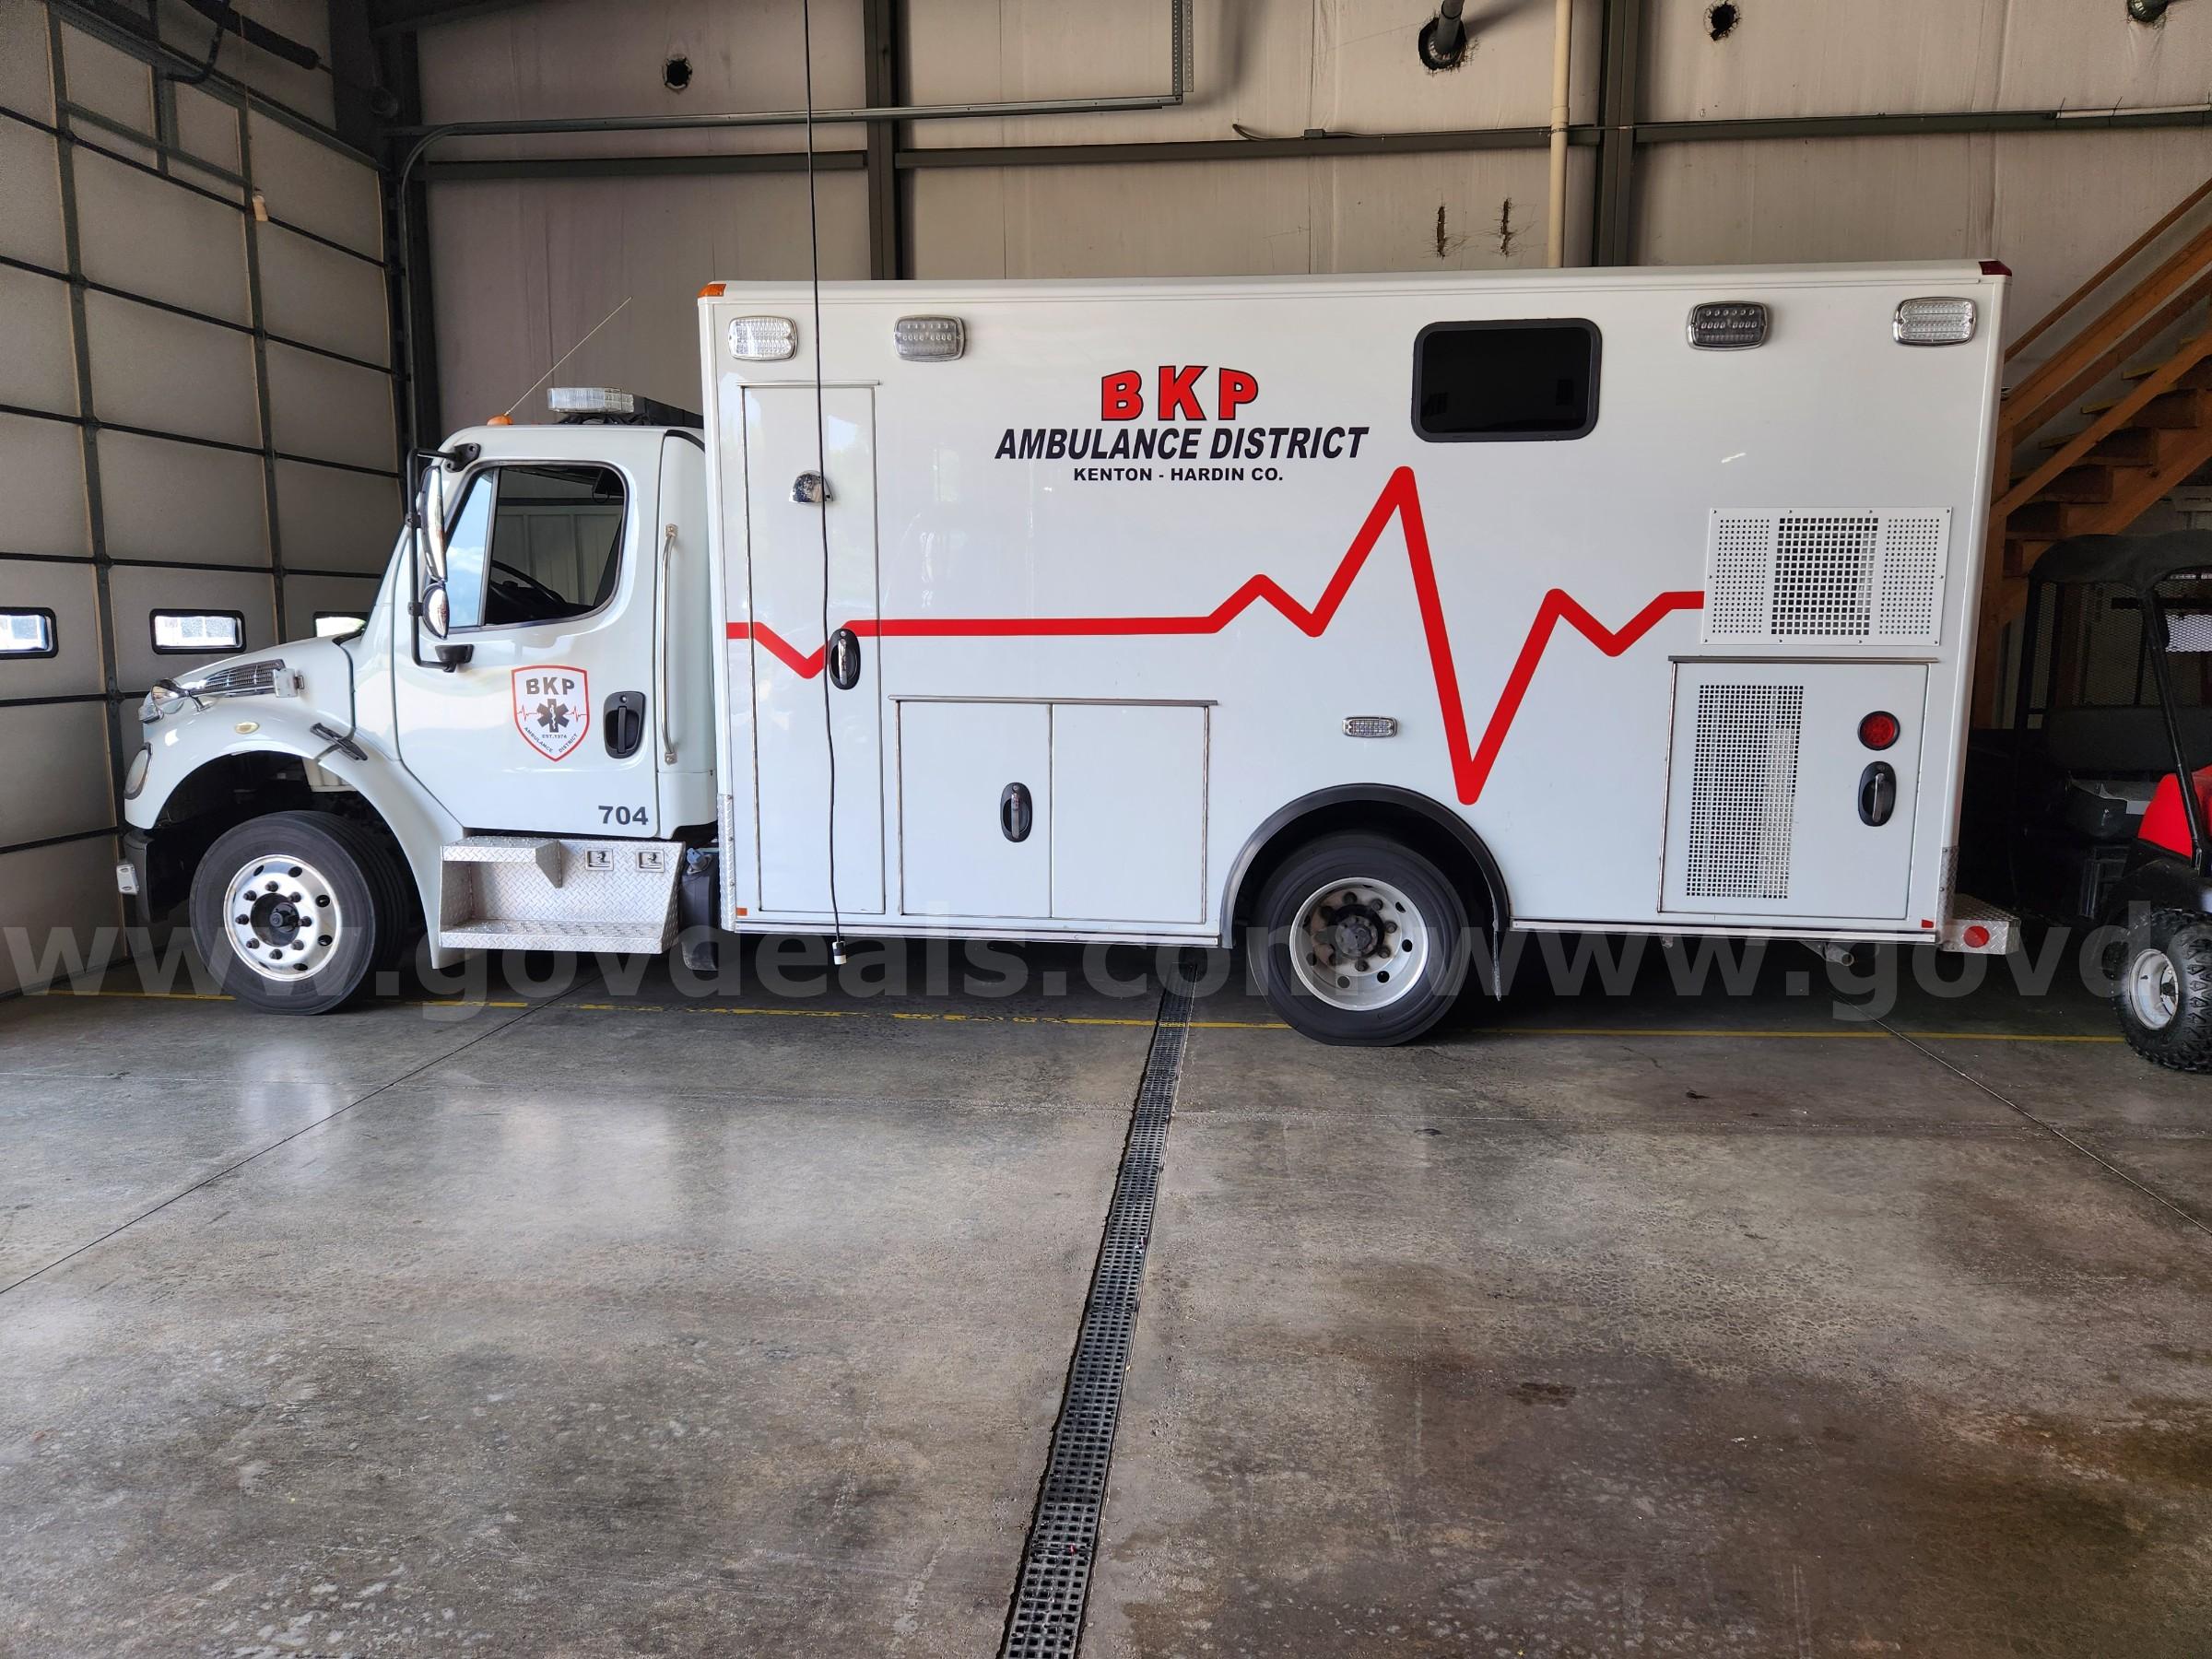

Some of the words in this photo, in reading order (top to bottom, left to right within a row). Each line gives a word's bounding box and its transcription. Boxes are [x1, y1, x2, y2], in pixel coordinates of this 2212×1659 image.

[1100, 365, 1259, 421] BKP
[994, 428, 1201, 460] AMBULANCE
[1209, 427, 1371, 459] DISTRICT
[1074, 467, 1153, 481] KENTON
[1171, 467, 1244, 481] HARDIN
[1251, 467, 1283, 481] CO.
[525, 677, 575, 696] BKP
[524, 727, 554, 753] AMBULANCE
[559, 733, 579, 753] DISTRICT
[598, 806, 649, 826] 704
